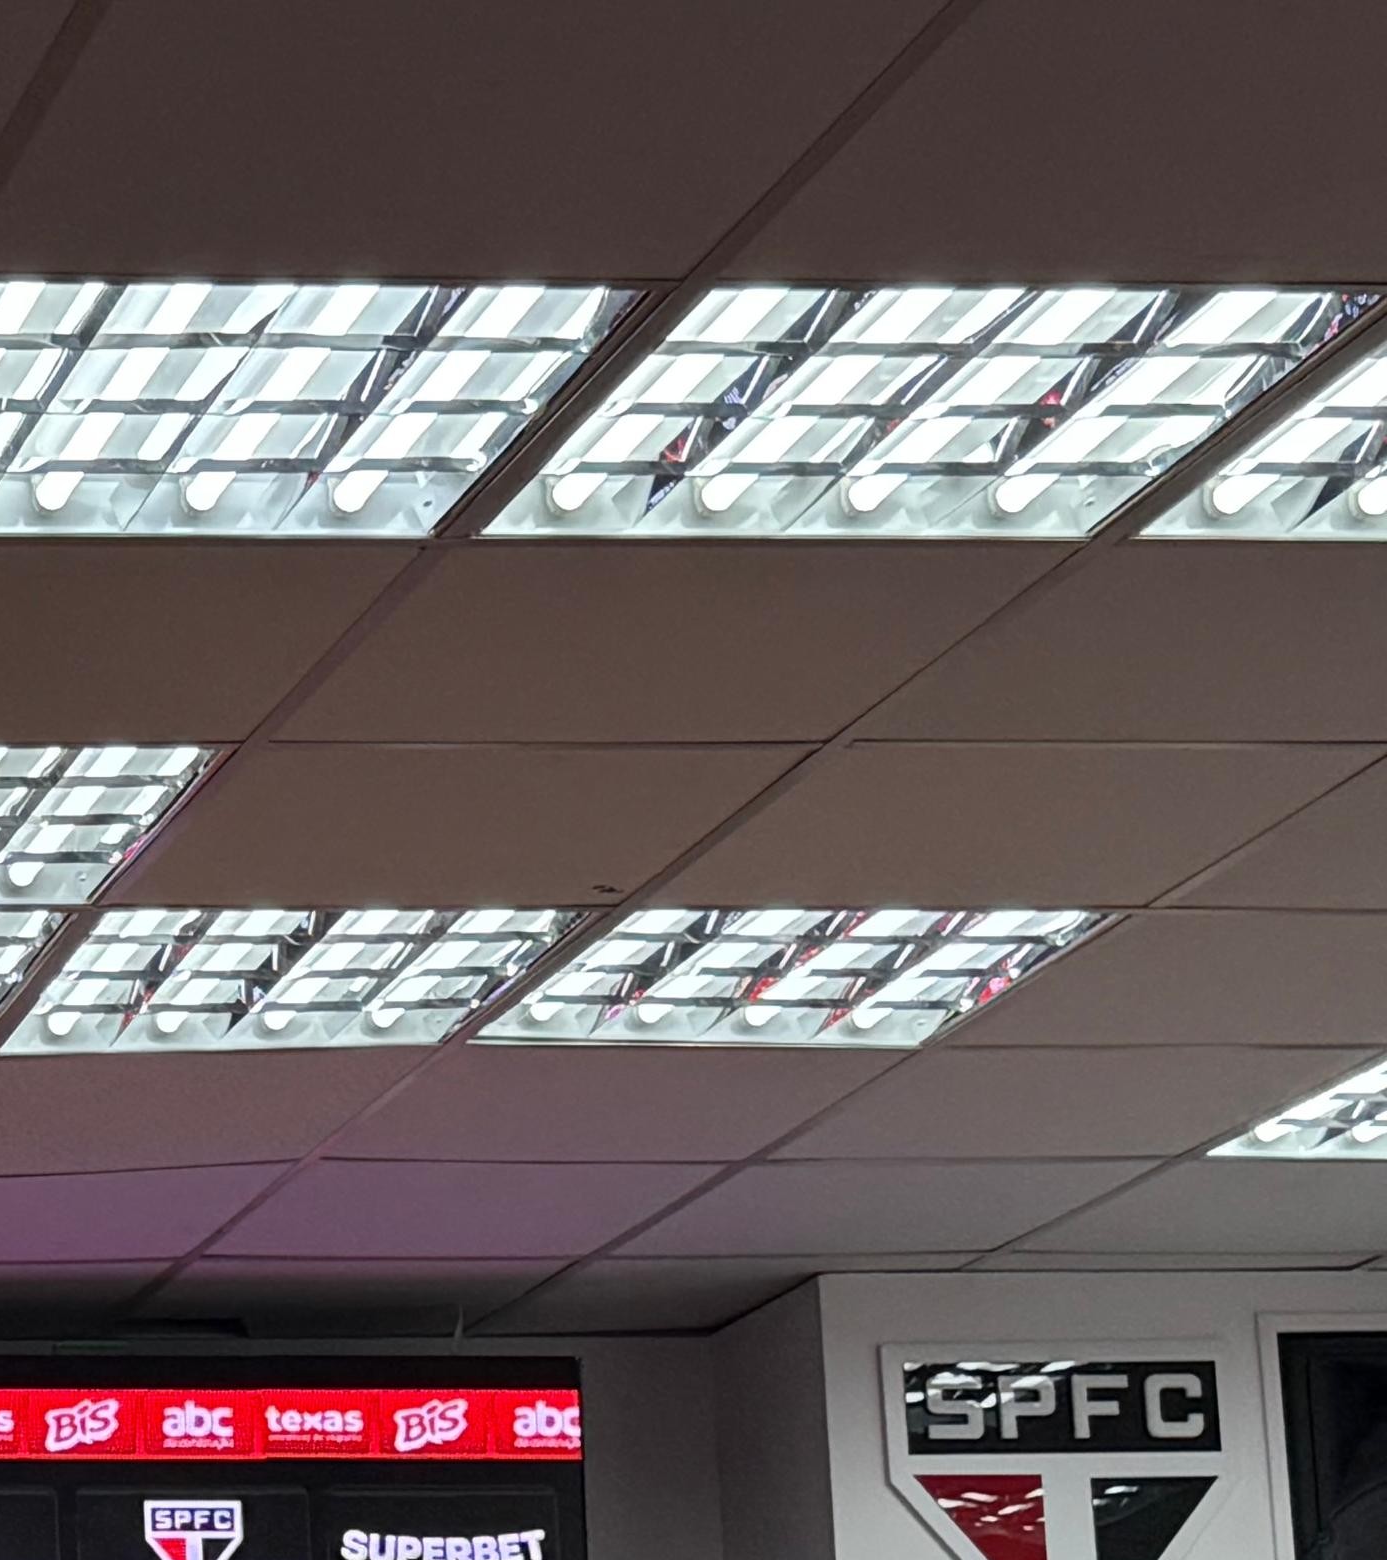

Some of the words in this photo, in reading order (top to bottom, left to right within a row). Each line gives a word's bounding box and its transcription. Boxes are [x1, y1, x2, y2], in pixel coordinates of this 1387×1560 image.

[162, 1400, 234, 1438] abc
[265, 1405, 363, 1433] texas
[513, 1400, 580, 1438] abc
[927, 1372, 1206, 1440] SPFC
[154, 1509, 233, 1530] SPFC
